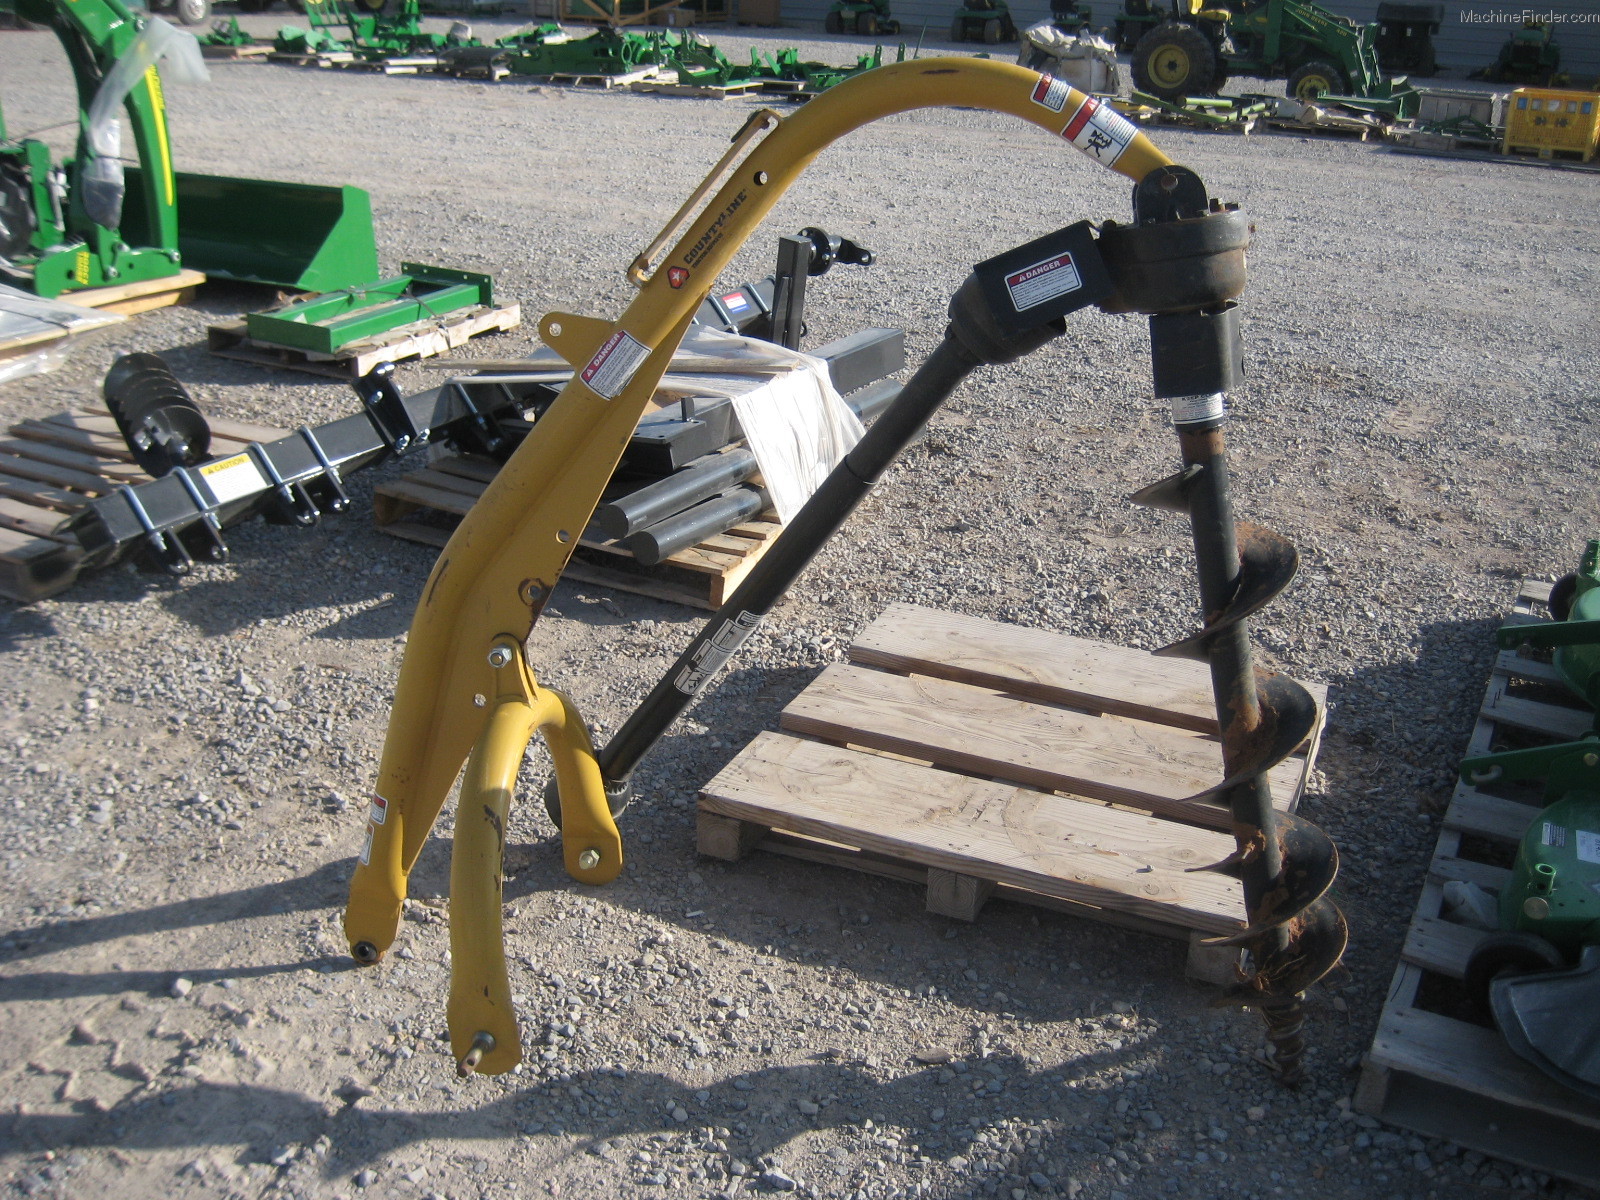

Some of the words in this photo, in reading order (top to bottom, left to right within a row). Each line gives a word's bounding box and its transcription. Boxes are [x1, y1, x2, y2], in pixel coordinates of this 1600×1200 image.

[1026, 260, 1061, 279] DANGER
[593, 333, 620, 367] DANGER
[214, 457, 245, 471] CAUTION
